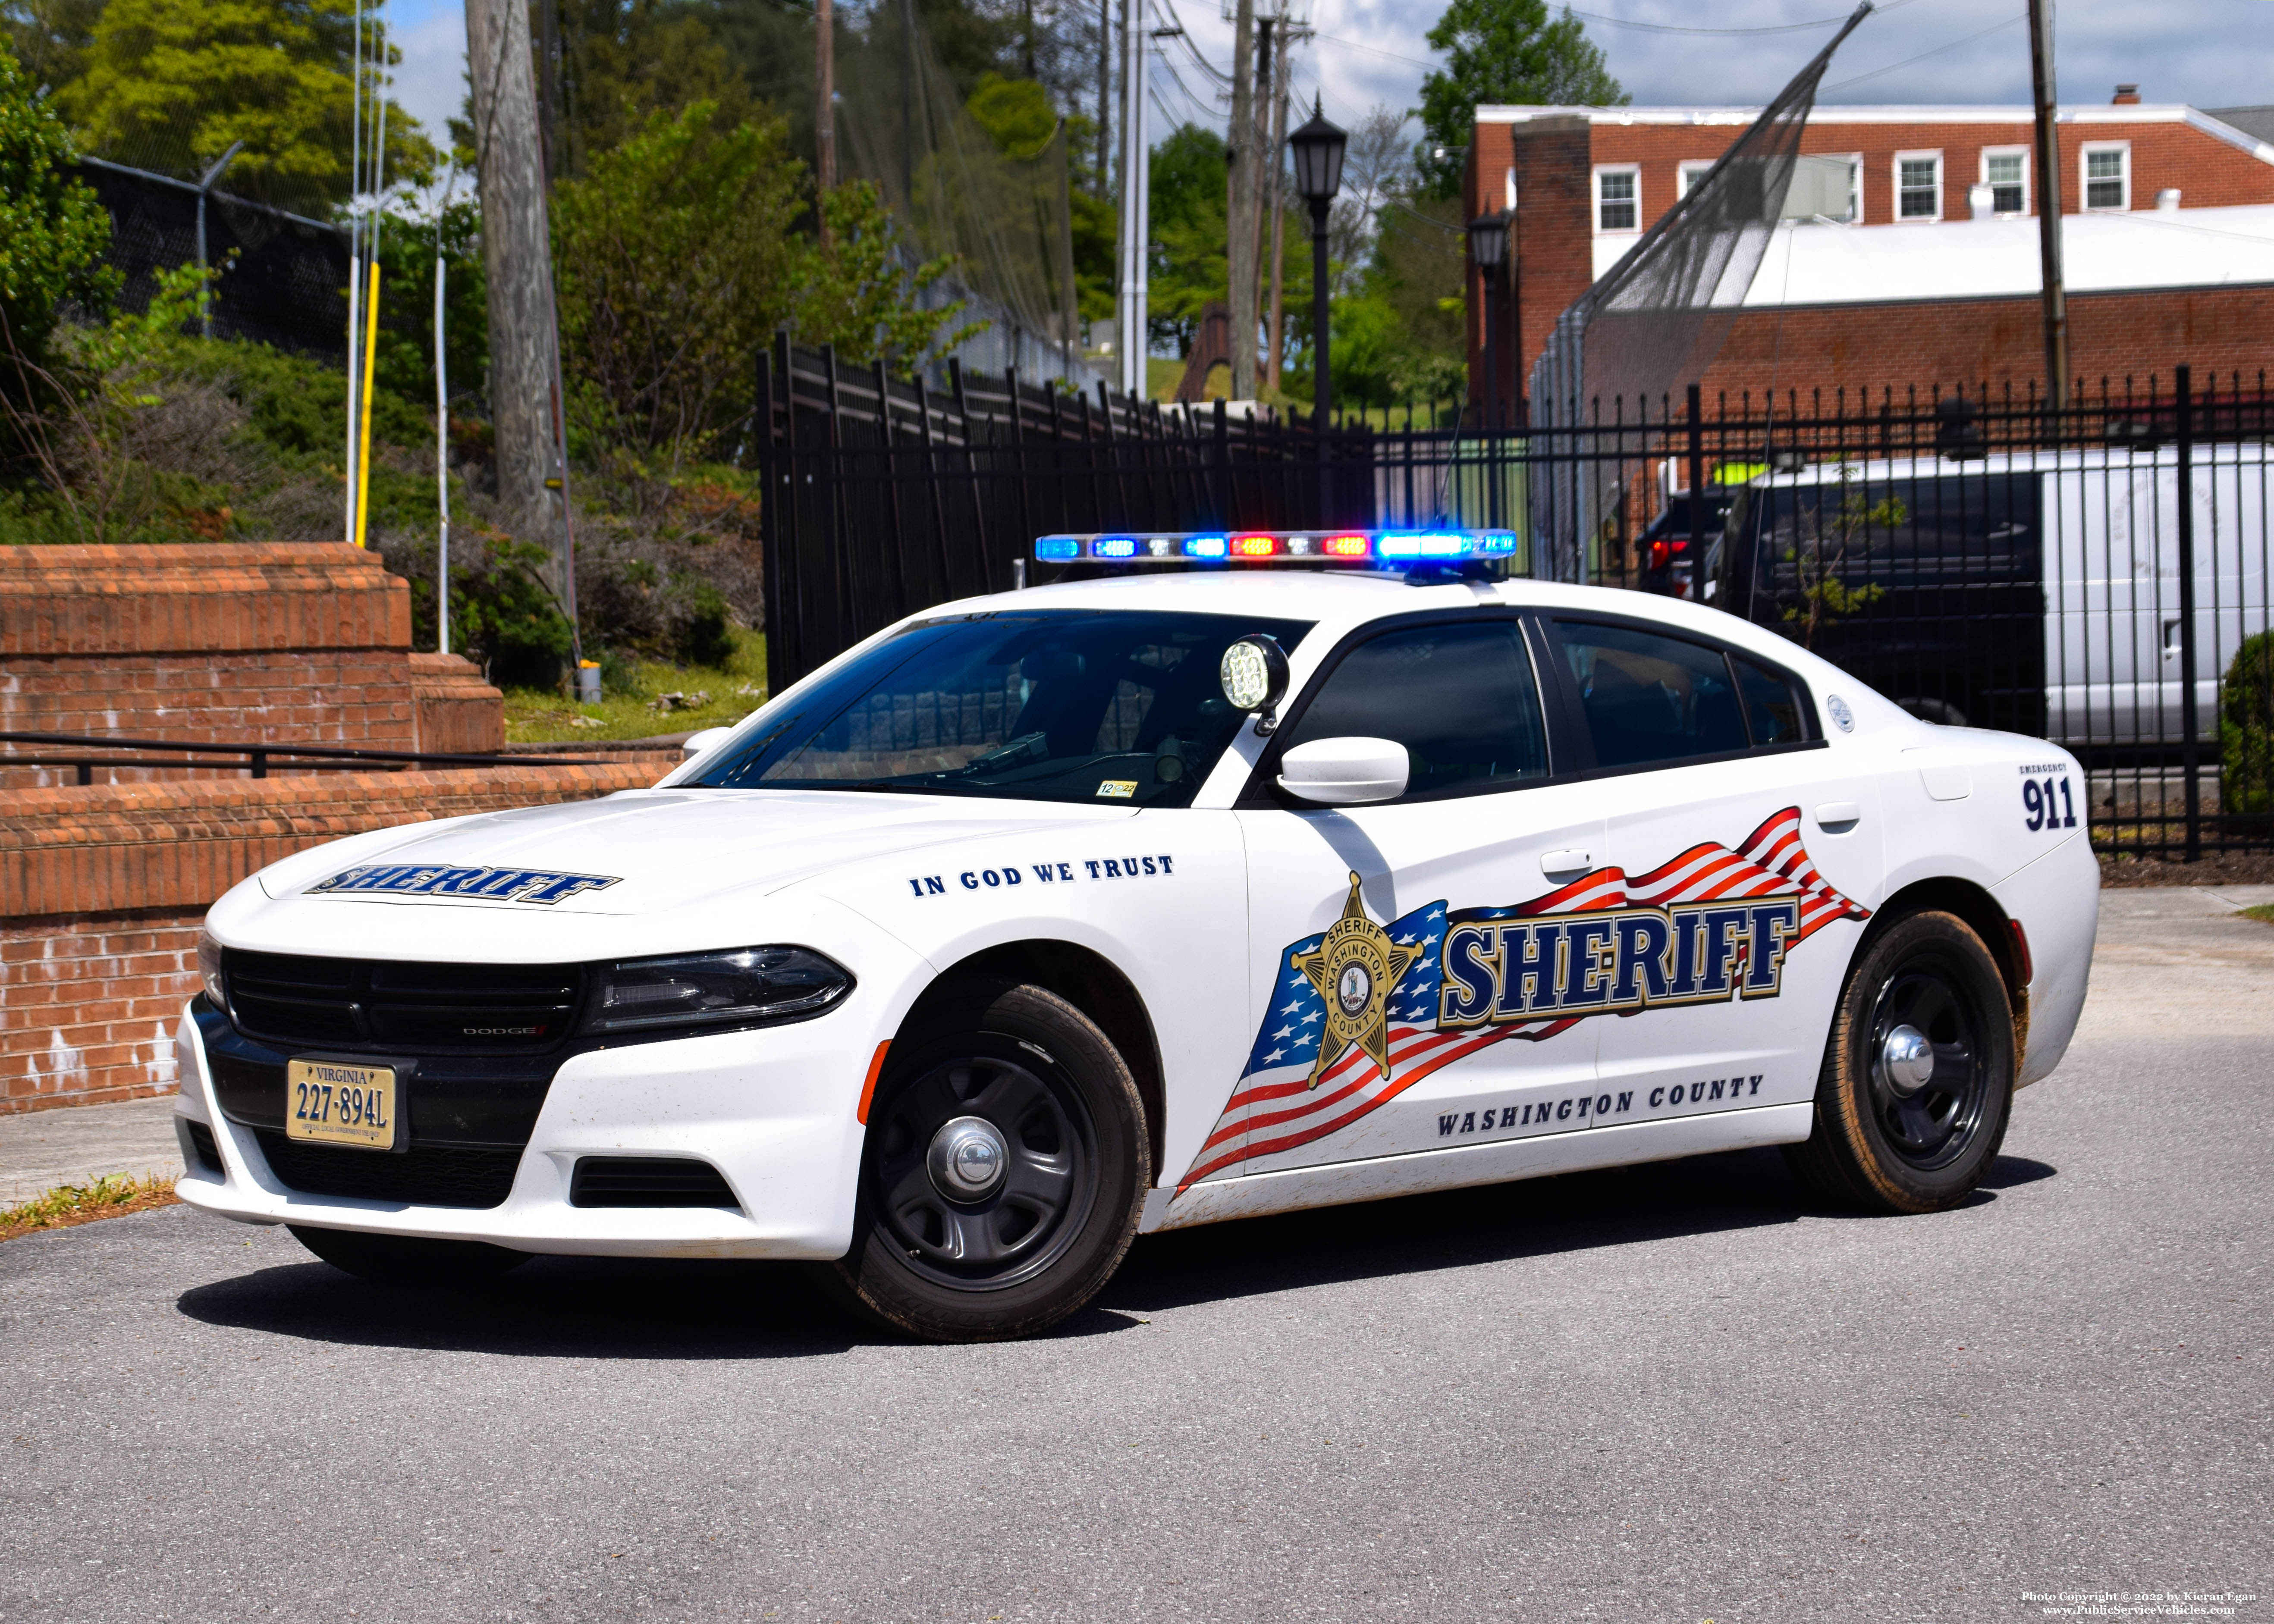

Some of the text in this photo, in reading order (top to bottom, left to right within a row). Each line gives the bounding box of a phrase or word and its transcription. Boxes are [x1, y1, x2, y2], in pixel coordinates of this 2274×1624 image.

[1102, 784, 1113, 793] 12
[2020, 763, 2067, 774] EMERGENCY
[2023, 776, 2077, 831] 911
[301, 864, 625, 905] SHERIFF
[908, 855, 1174, 897] IN GOD WE TRUST
[1328, 919, 1382, 944] SHERIFF
[1328, 944, 1383, 990] WASHINGTON
[1437, 894, 1801, 1031] SHERIFF
[1333, 1004, 1378, 1035] COUNTY
[317, 1067, 367, 1085] VIRGINIA
[296, 1082, 387, 1128] 227-894L
[1439, 1075, 1763, 1137] WASHINGTON COUNTY
